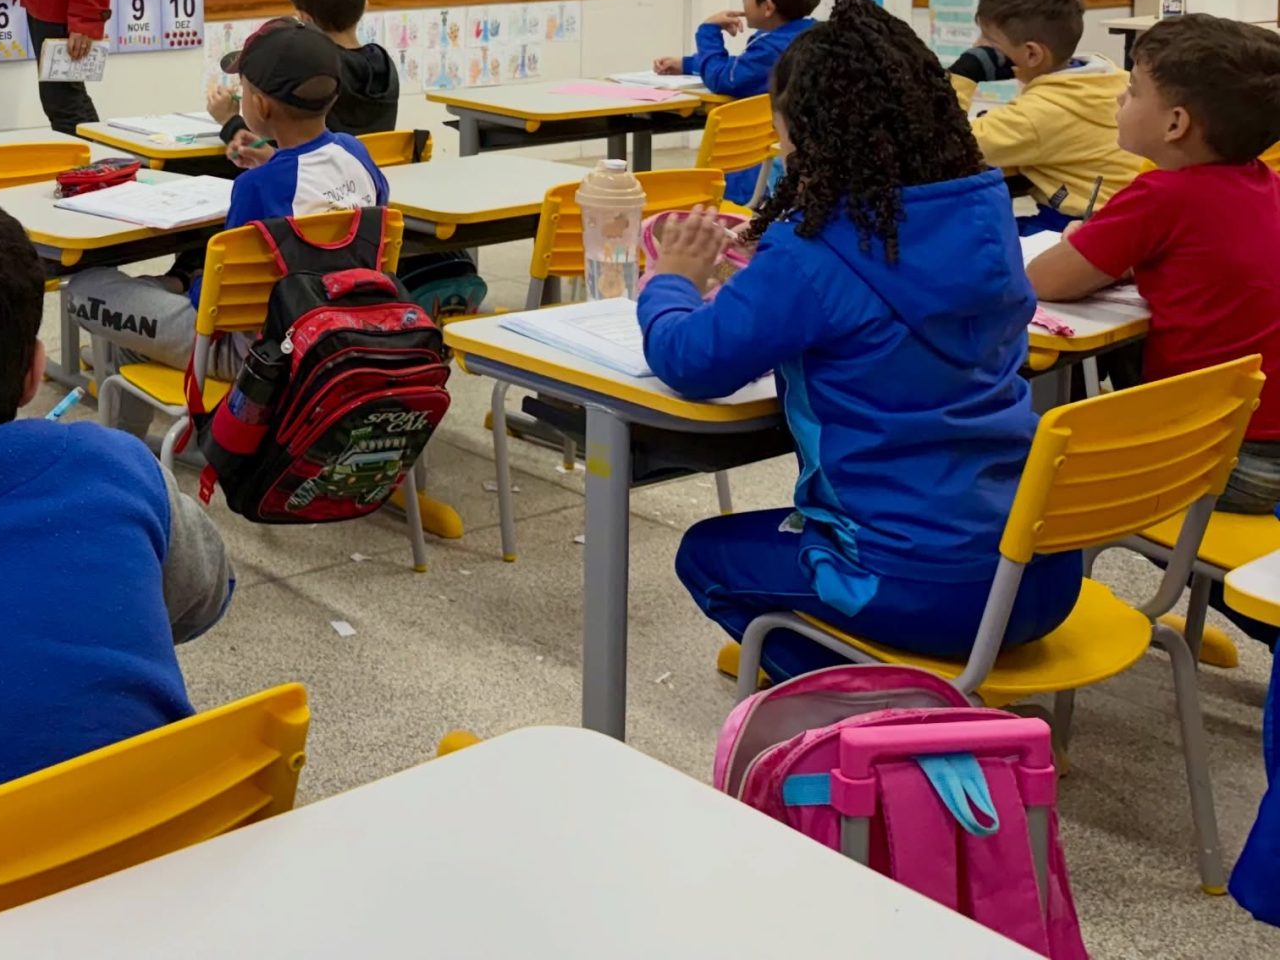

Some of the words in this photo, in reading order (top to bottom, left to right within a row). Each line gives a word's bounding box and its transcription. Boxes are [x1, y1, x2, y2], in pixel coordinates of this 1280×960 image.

[128, 22, 150, 32] NOVE
[175, 20, 191, 30] DEZ
[364, 410, 433, 424] SPORT
[387, 419, 429, 433] CAR
